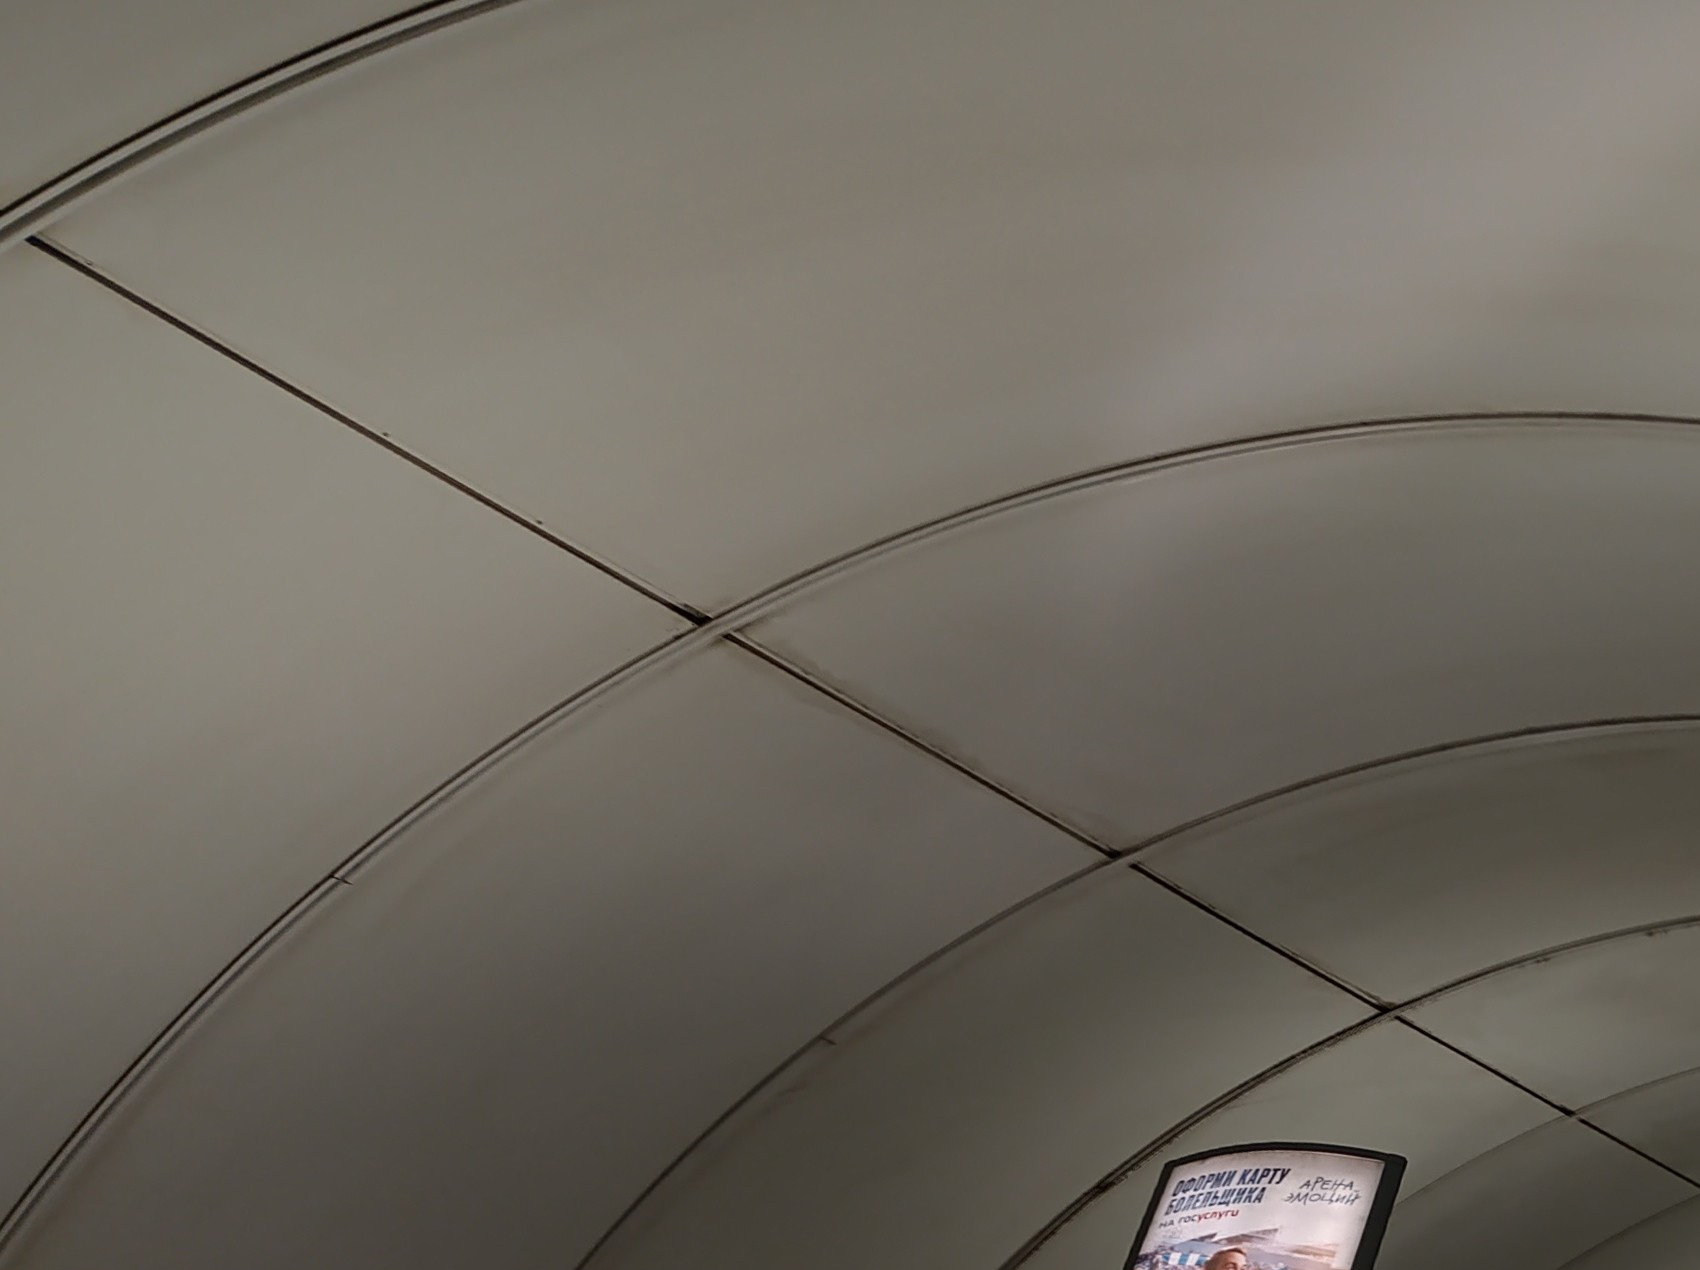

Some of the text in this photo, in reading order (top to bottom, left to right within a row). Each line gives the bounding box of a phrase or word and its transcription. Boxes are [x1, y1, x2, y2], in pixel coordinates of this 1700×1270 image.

[1171, 1168, 1292, 1198] ОФОРМИ КАРТУ
[1299, 1176, 1354, 1191] АРЕНА
[1165, 1187, 1267, 1217] БОЛЕЛЬЩИКА
[1284, 1190, 1361, 1206] ЭМОЦИЙ
